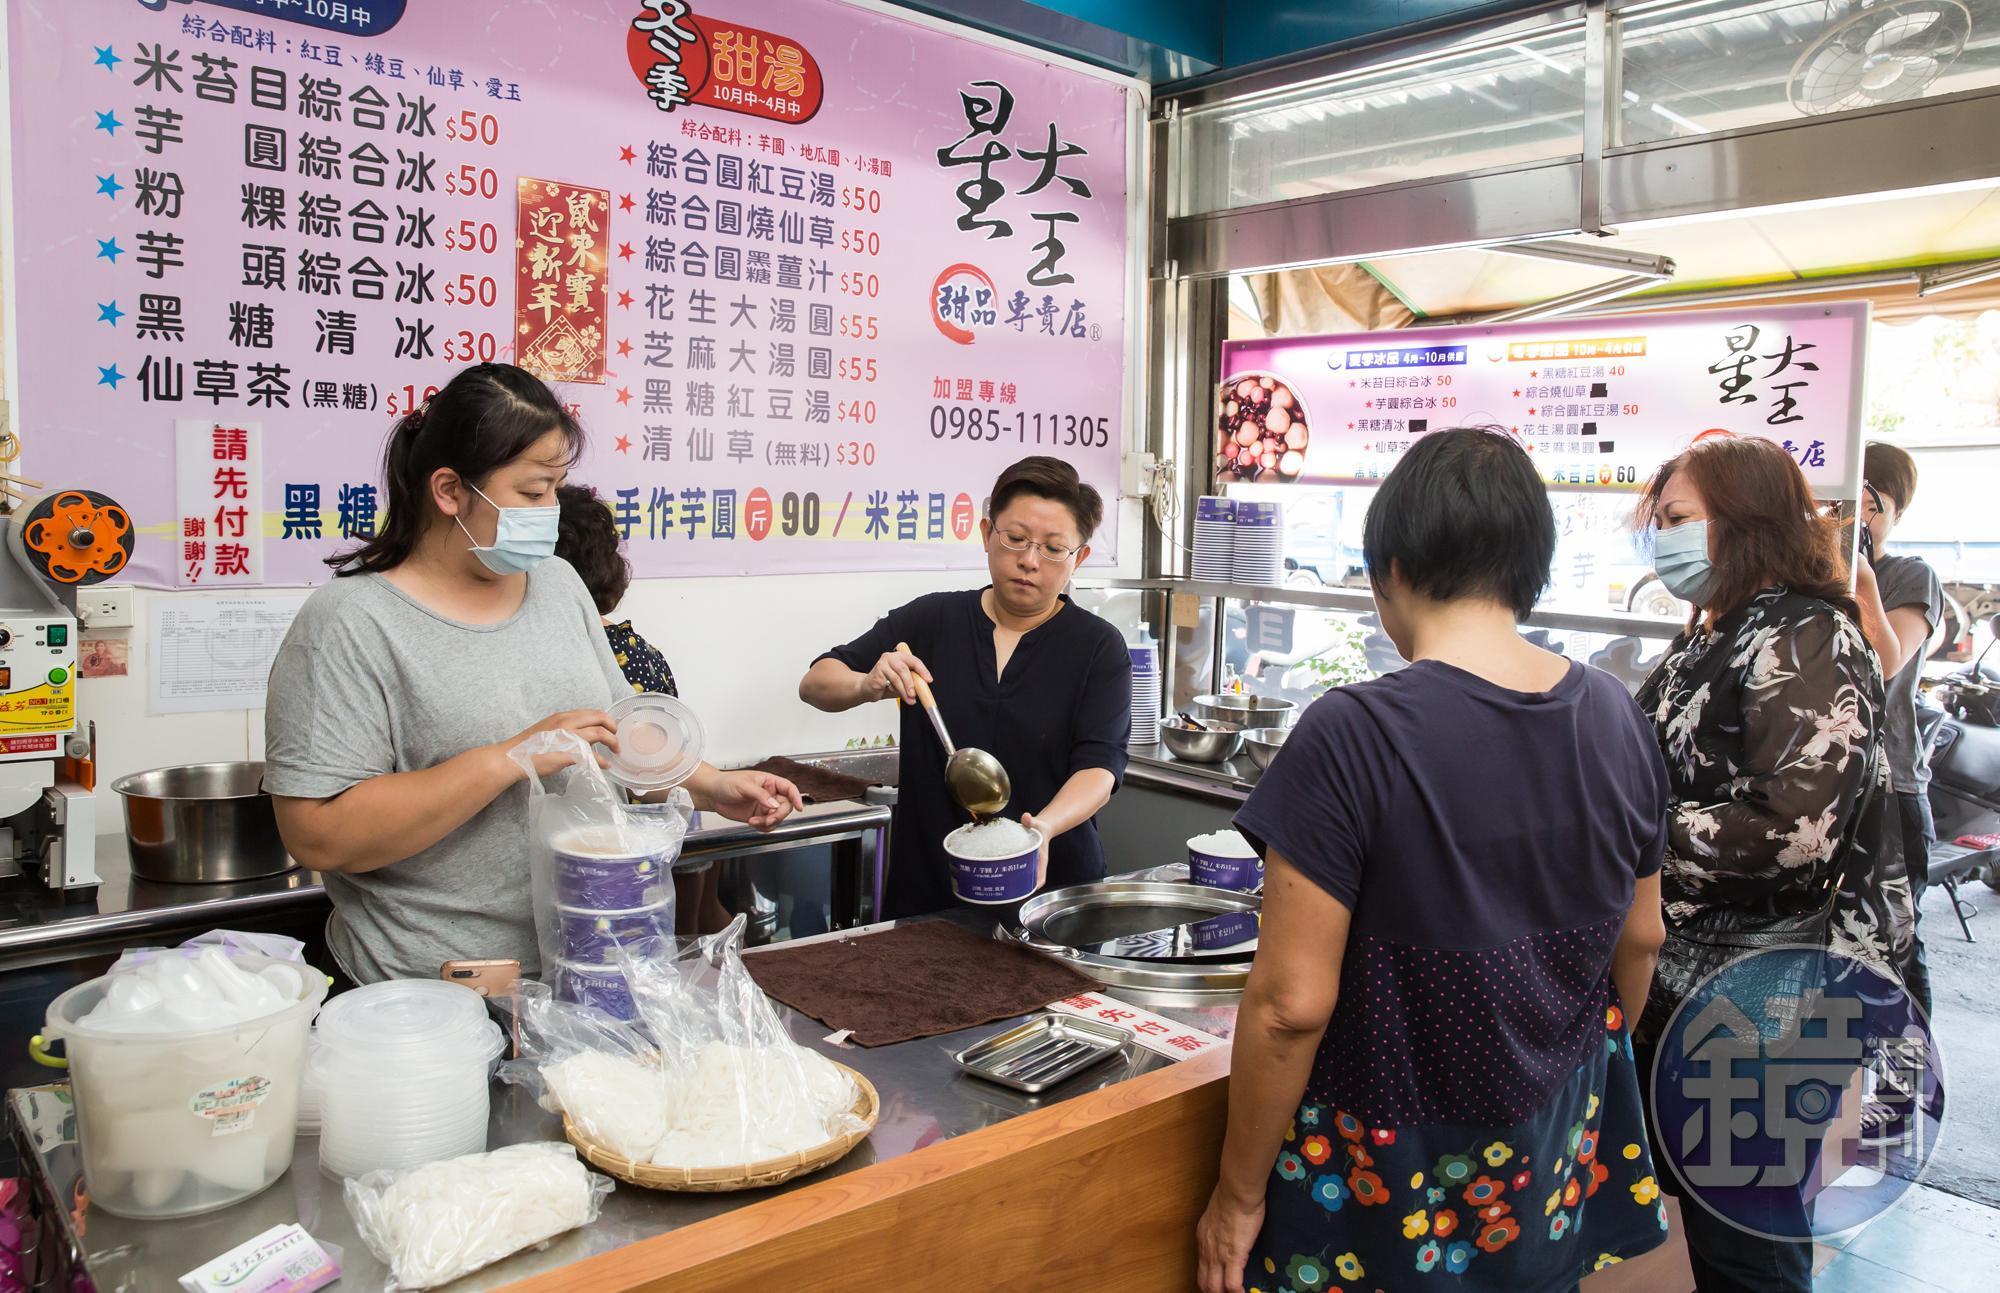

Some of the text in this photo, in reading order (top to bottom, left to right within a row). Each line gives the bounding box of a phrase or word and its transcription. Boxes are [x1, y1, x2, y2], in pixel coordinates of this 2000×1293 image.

[712, 30, 806, 96] 甜湯
[133, 42, 499, 147] 米苔目綜合冰 $50
[444, 167, 498, 200] $50
[646, 141, 881, 215] 綜合圓紅豆湯 $50
[444, 223, 497, 255] $50
[646, 190, 880, 256] 綜合圓燒仙草 $50
[444, 276, 497, 308] $50
[840, 273, 880, 298] $50
[644, 284, 879, 341] 花生大湯圓 $55
[443, 331, 497, 363] $30
[643, 332, 878, 383] 芝麻大湯圓 $55
[1361, 375, 1452, 389] 米苔目綜合冰 50
[1609, 366, 1624, 376] 40
[934, 377, 1017, 404] 加盟專線
[1442, 397, 1457, 407] 50
[837, 400, 876, 424] $40
[1357, 419, 1405, 432] 黑糖清冰
[1623, 405, 1638, 415] 50
[930, 405, 1109, 448] 0985-111305
[836, 441, 876, 466] $30
[1617, 466, 1635, 483] 60
[212, 427, 250, 576] 請先付款
[615, 486, 736, 541] 手作芋圓
[782, 491, 820, 536] 90
[865, 489, 945, 540] 米苔目
